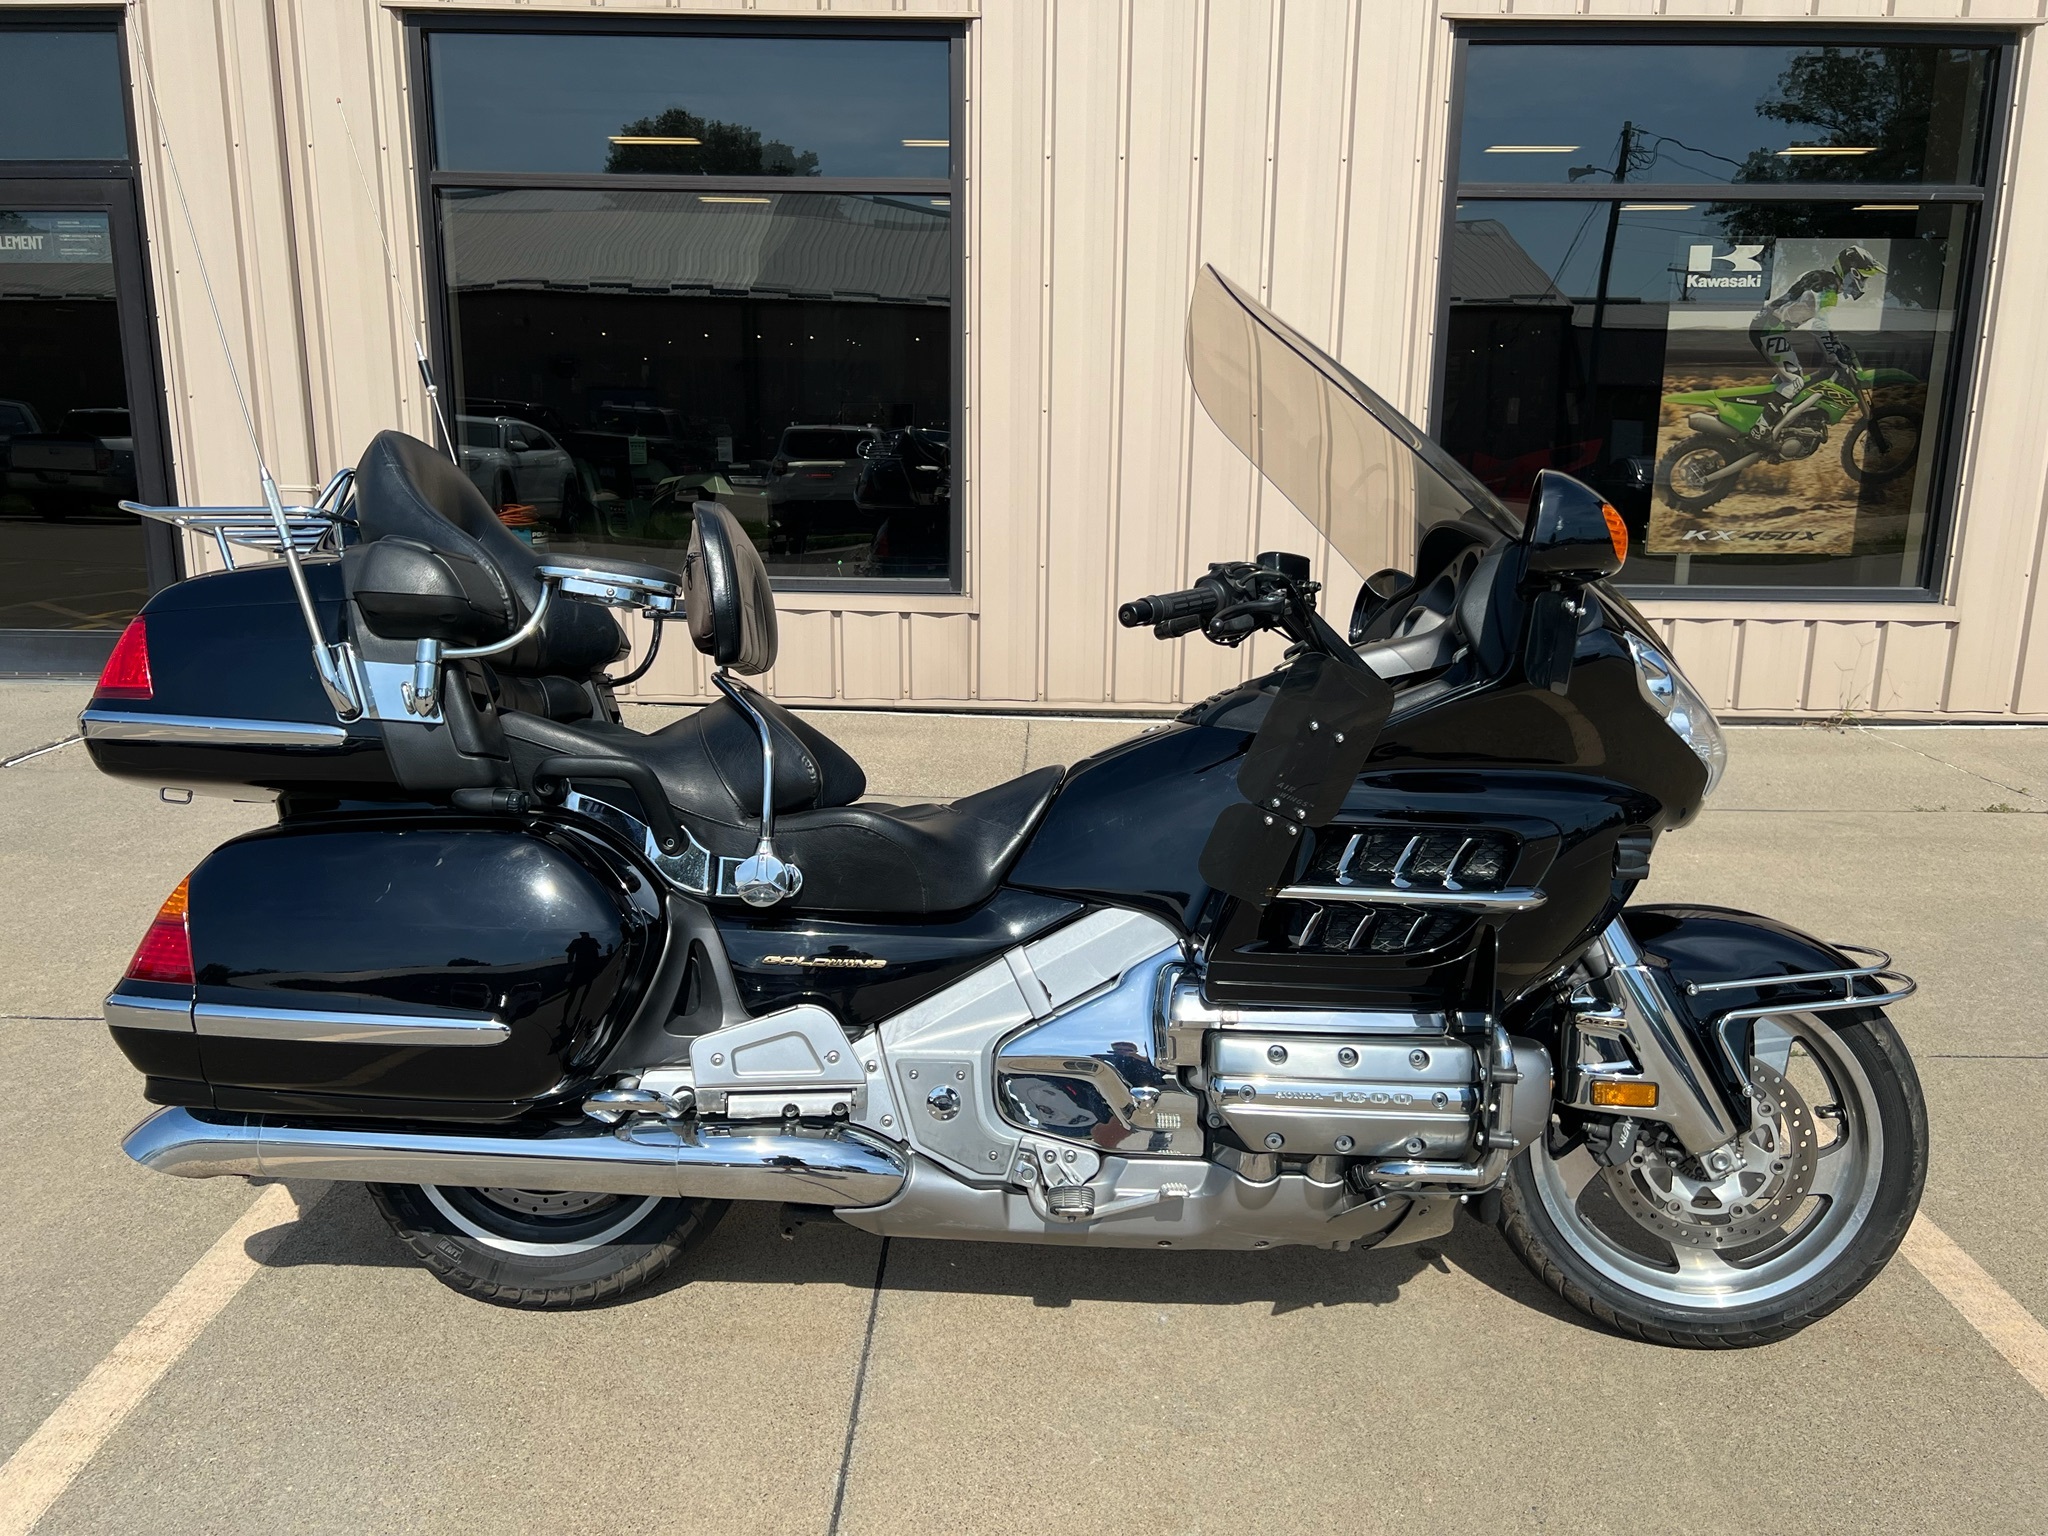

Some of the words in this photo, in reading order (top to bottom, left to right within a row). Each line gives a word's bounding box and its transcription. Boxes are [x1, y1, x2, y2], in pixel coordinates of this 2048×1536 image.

[1686, 274, 1761, 288] Kawasaki
[1276, 782, 1296, 793] AIR
[1274, 1090, 1323, 1100] HONDA
[1328, 1091, 1413, 1105] 1800
